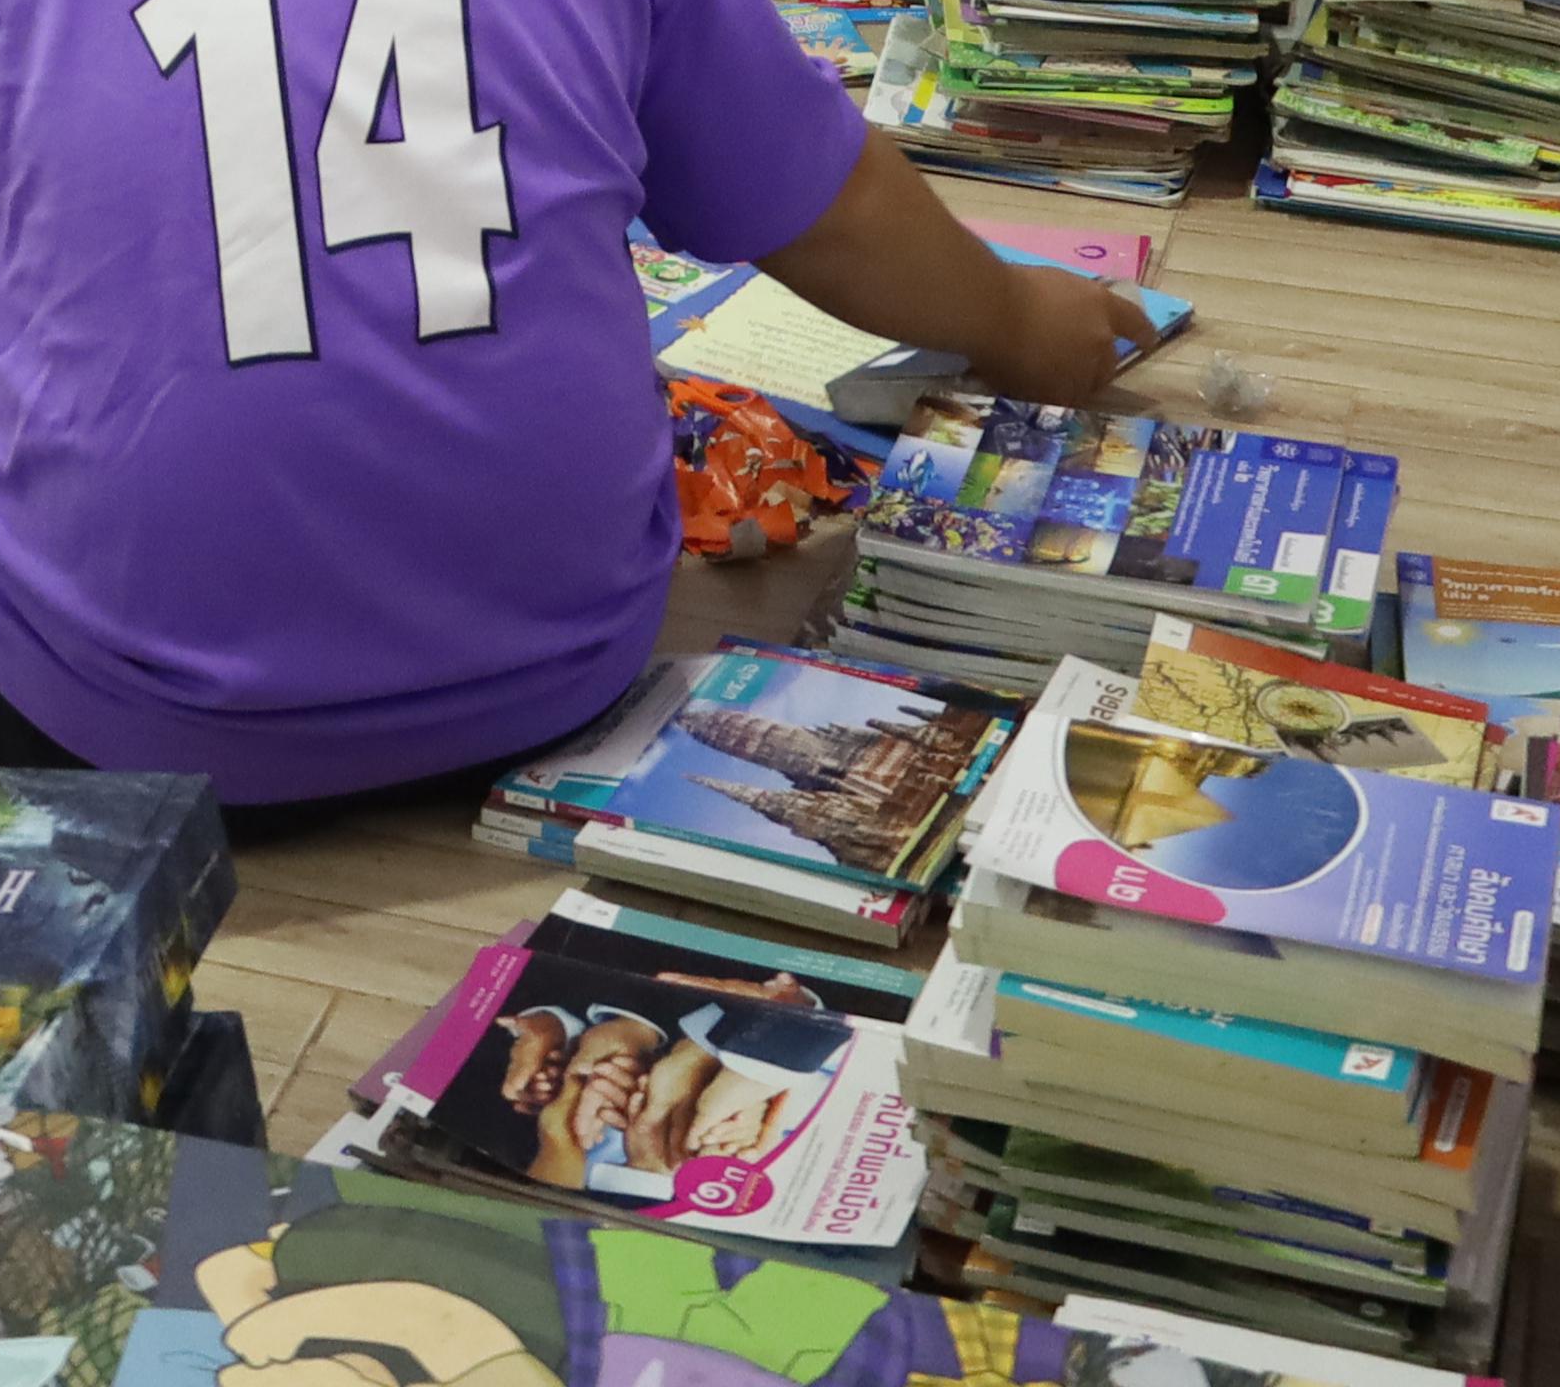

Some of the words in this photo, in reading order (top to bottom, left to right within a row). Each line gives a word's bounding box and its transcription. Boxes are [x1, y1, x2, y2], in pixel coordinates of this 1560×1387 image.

[1457, 868, 1512, 965] สังคมศึกษา
[825, 1093, 914, 1235] หน้าที่พลเมือง
